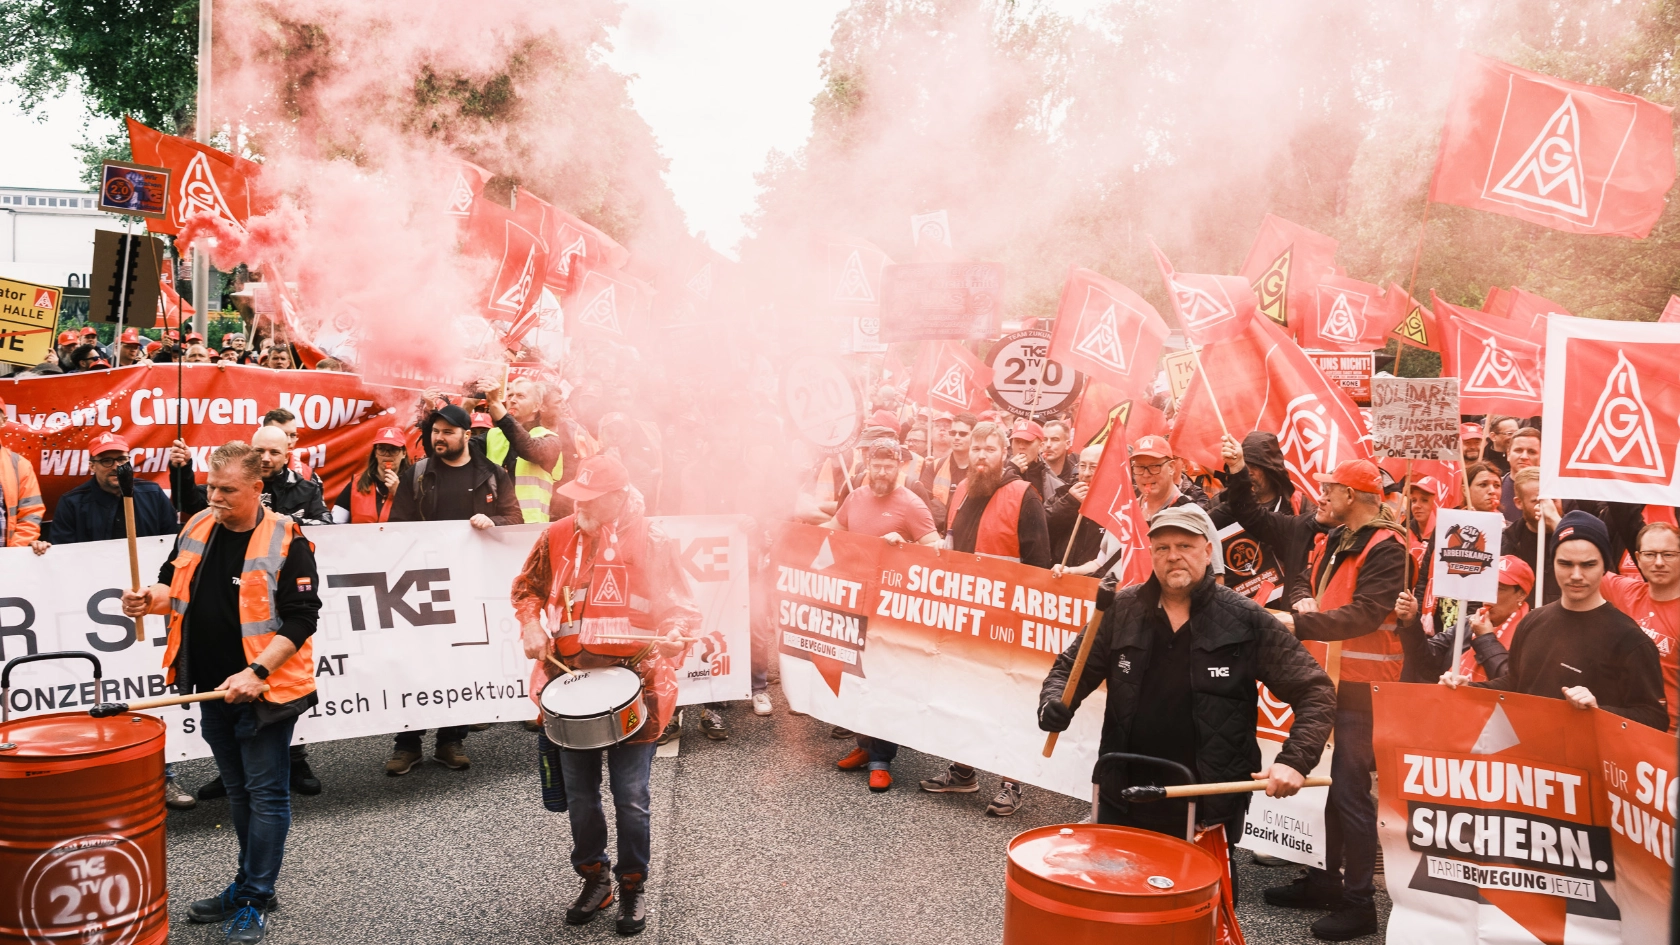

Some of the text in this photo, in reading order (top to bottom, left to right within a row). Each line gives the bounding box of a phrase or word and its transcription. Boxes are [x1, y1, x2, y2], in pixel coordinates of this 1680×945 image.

[111, 184, 128, 195] 2.0
[3, 304, 44, 320] HALLE
[1008, 331, 1028, 341] TEAM
[1020, 344, 1047, 358] TKE
[1026, 359, 1041, 368] TV
[1319, 357, 1339, 371] UNS
[1340, 357, 1371, 371] NICHT!
[1003, 357, 1063, 387] 2.0
[1174, 360, 1194, 375] TK
[1233, 547, 1255, 567] 2.0
[1443, 549, 1492, 562] ARBEITSKAMPF
[1450, 563, 1480, 572] TEPPER
[327, 567, 456, 631] TKE
[776, 565, 862, 609] ZUKUNFT
[881, 569, 903, 588] FÜR
[906, 564, 1006, 609] SICHERE
[779, 600, 865, 647] SICHERN.
[876, 589, 986, 637] ZUKUNFT
[990, 623, 1015, 644] UND
[1208, 666, 1230, 678] TKE
[1403, 754, 1581, 816] ZUKUNFT
[1602, 759, 1629, 794] FÜR
[1263, 808, 1313, 838] IG METALL
[1244, 822, 1313, 855] Bezirk Küste
[1412, 807, 1608, 873] SICHERN.
[65, 856, 106, 880] TKE
[1430, 859, 1592, 898] TARIFBEWEGUNG JETZT
[50, 873, 130, 925] 2.0
[78, 878, 101, 896] TV
